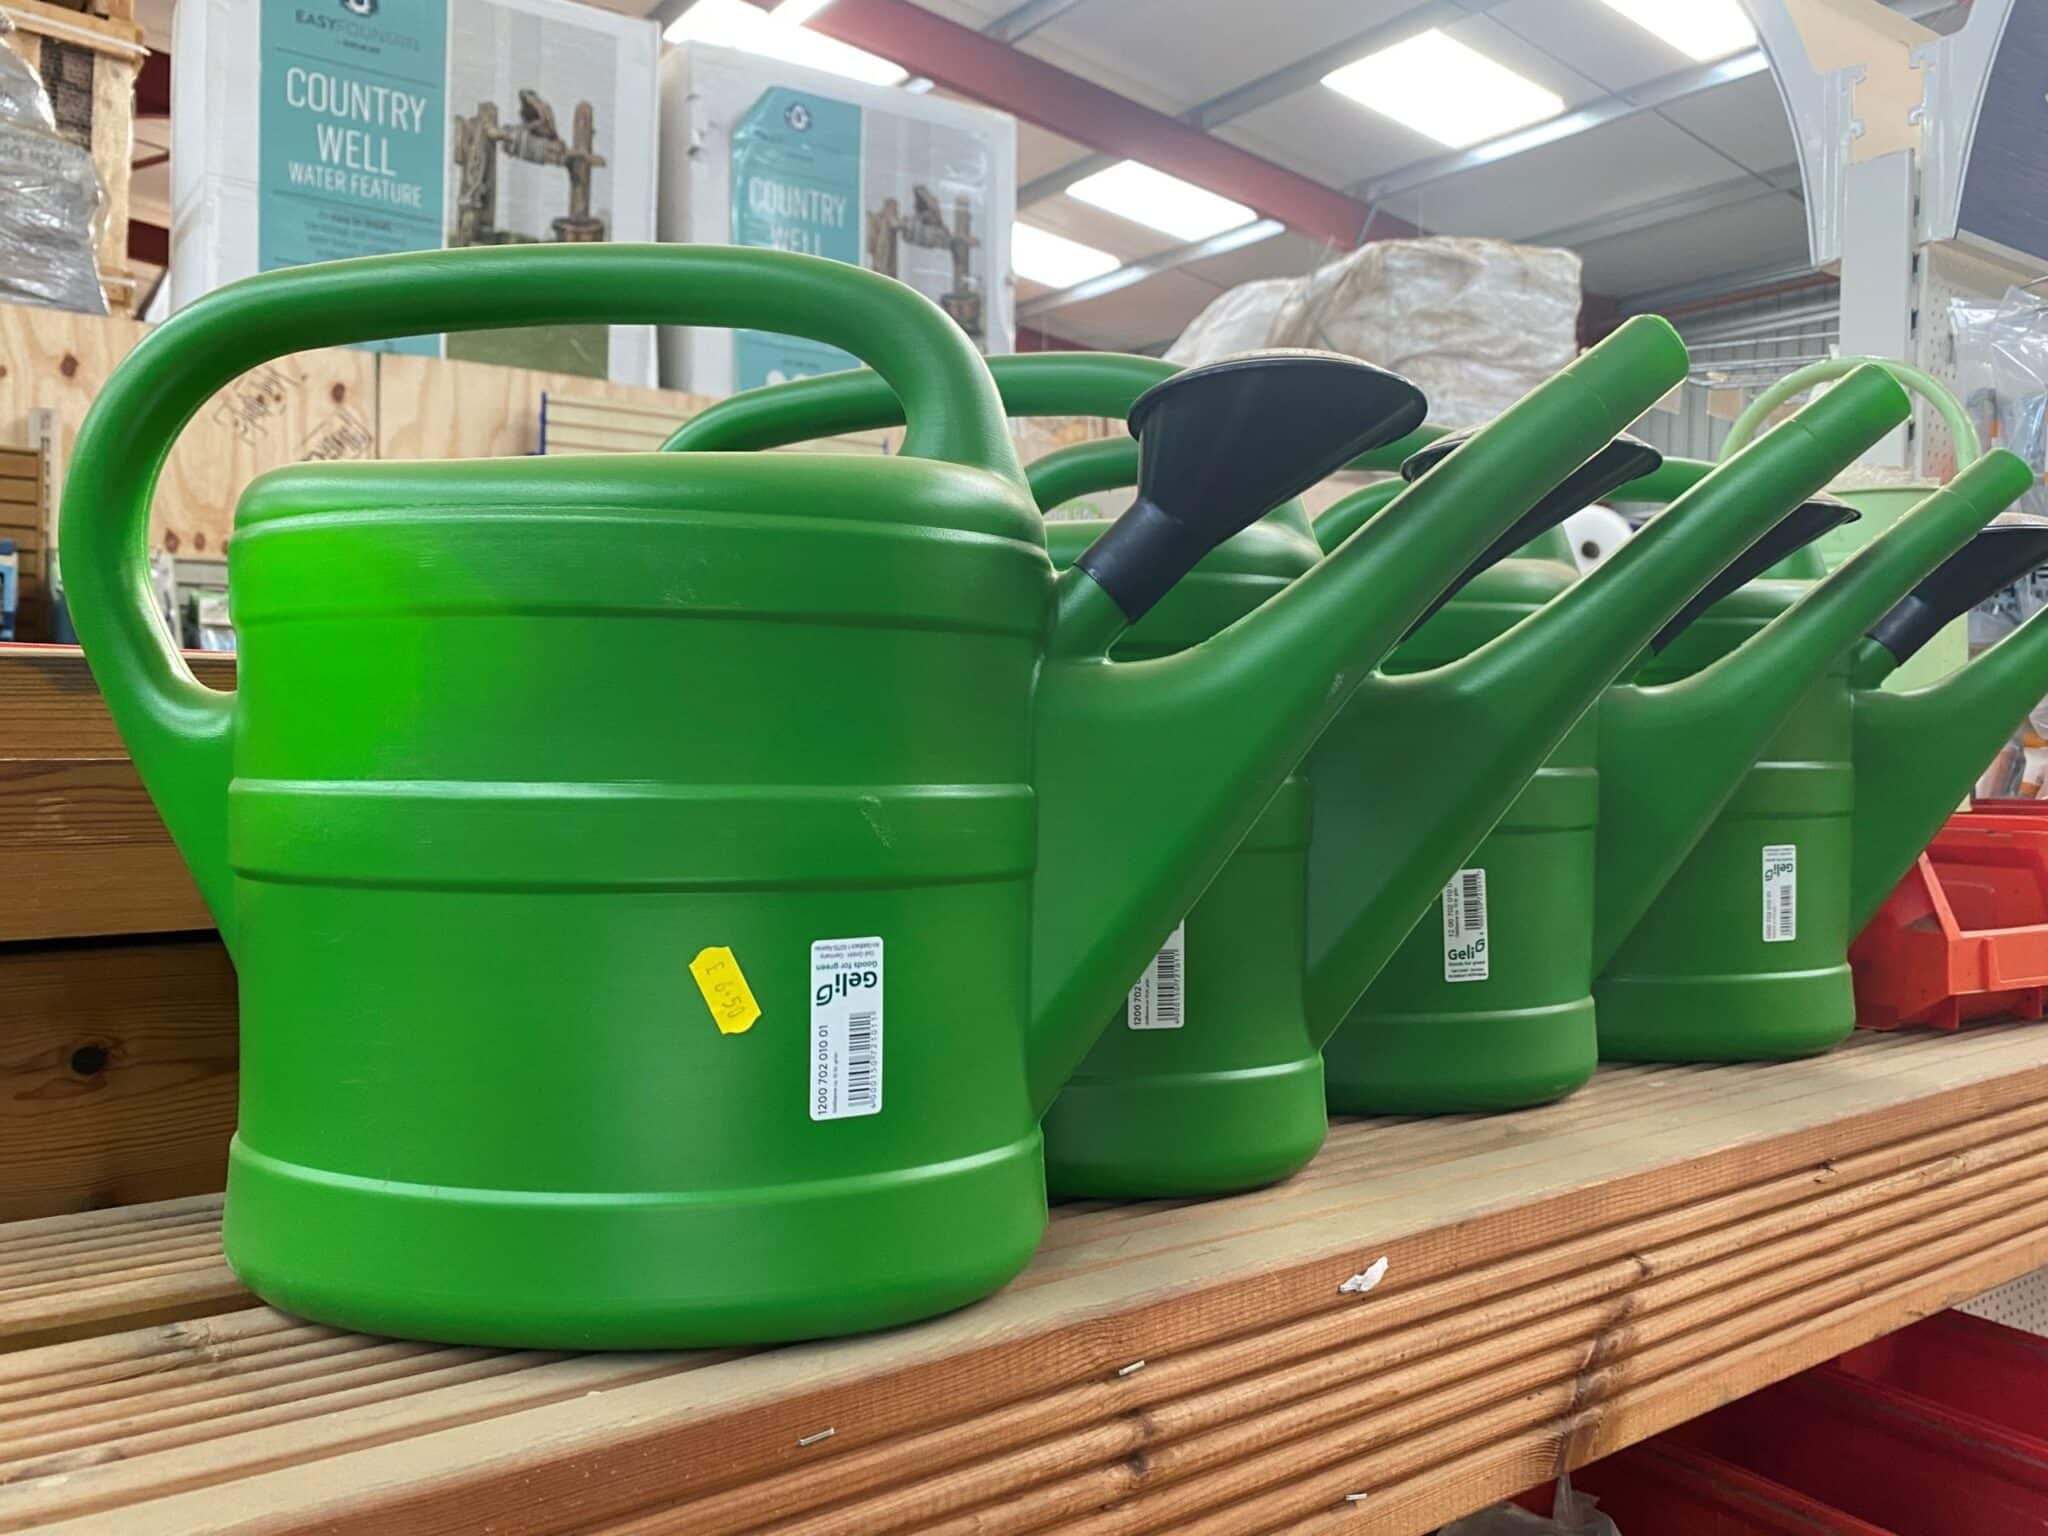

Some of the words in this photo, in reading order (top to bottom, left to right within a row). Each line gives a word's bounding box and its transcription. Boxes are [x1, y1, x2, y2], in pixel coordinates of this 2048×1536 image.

[287, 67, 427, 133] COUNTRY
[317, 123, 397, 177] WELL
[288, 160, 347, 193] WATER
[350, 173, 423, 208] FEATURE
[749, 177, 847, 229] COUNTRY
[1448, 944, 1475, 960] Geli
[816, 962, 839, 971] green
[841, 961, 852, 970] for
[835, 971, 878, 997] Geli
[1134, 1005, 1142, 1026] 1200
[818, 1025, 828, 1038] 01
[818, 1040, 828, 1061] 010
[818, 1063, 828, 1085] 702
[818, 1087, 828, 1115] 1200
